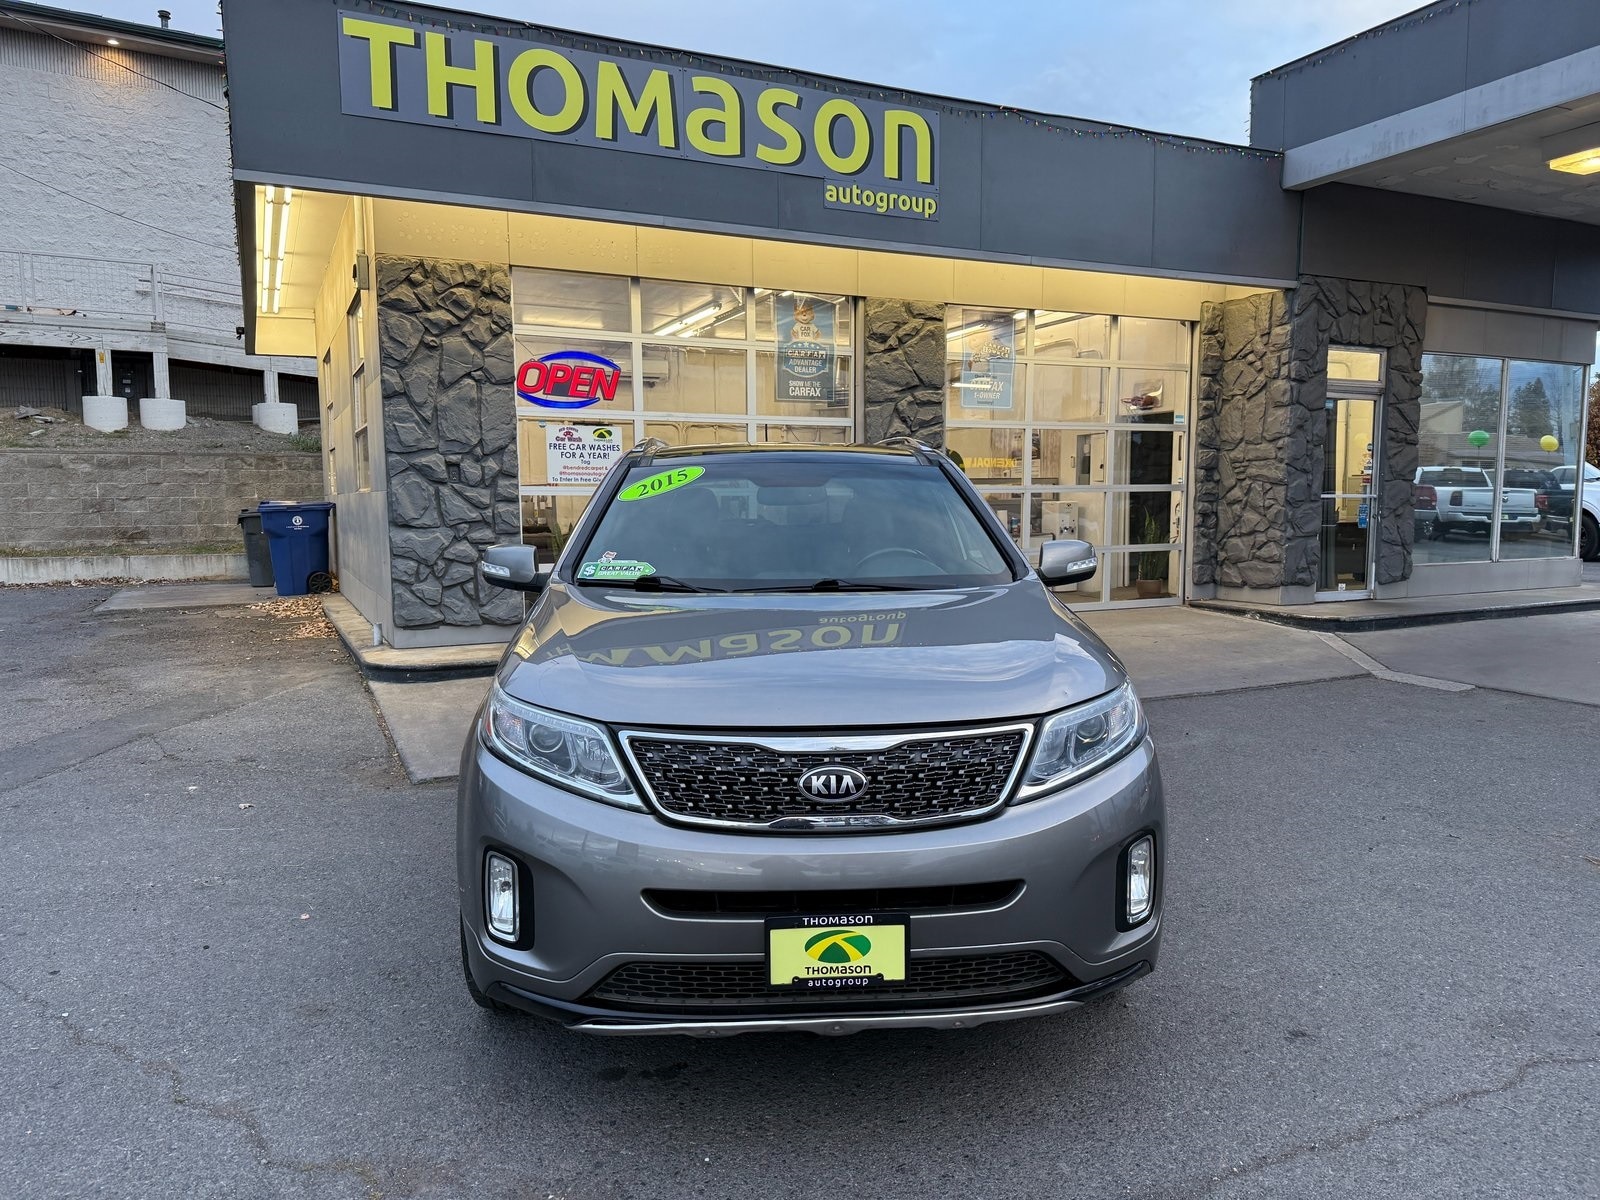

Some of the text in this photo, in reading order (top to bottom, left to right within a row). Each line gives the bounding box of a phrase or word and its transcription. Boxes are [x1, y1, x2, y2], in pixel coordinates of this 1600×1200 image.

[824, 183, 938, 219] autogroup
[517, 361, 621, 400] OPEN
[789, 387, 821, 397] CARFAX
[549, 443, 567, 451] FREE
[569, 443, 586, 451] CAR
[637, 469, 689, 498] 2015
[811, 775, 857, 794] KIA
[807, 977, 869, 988] autogroup
